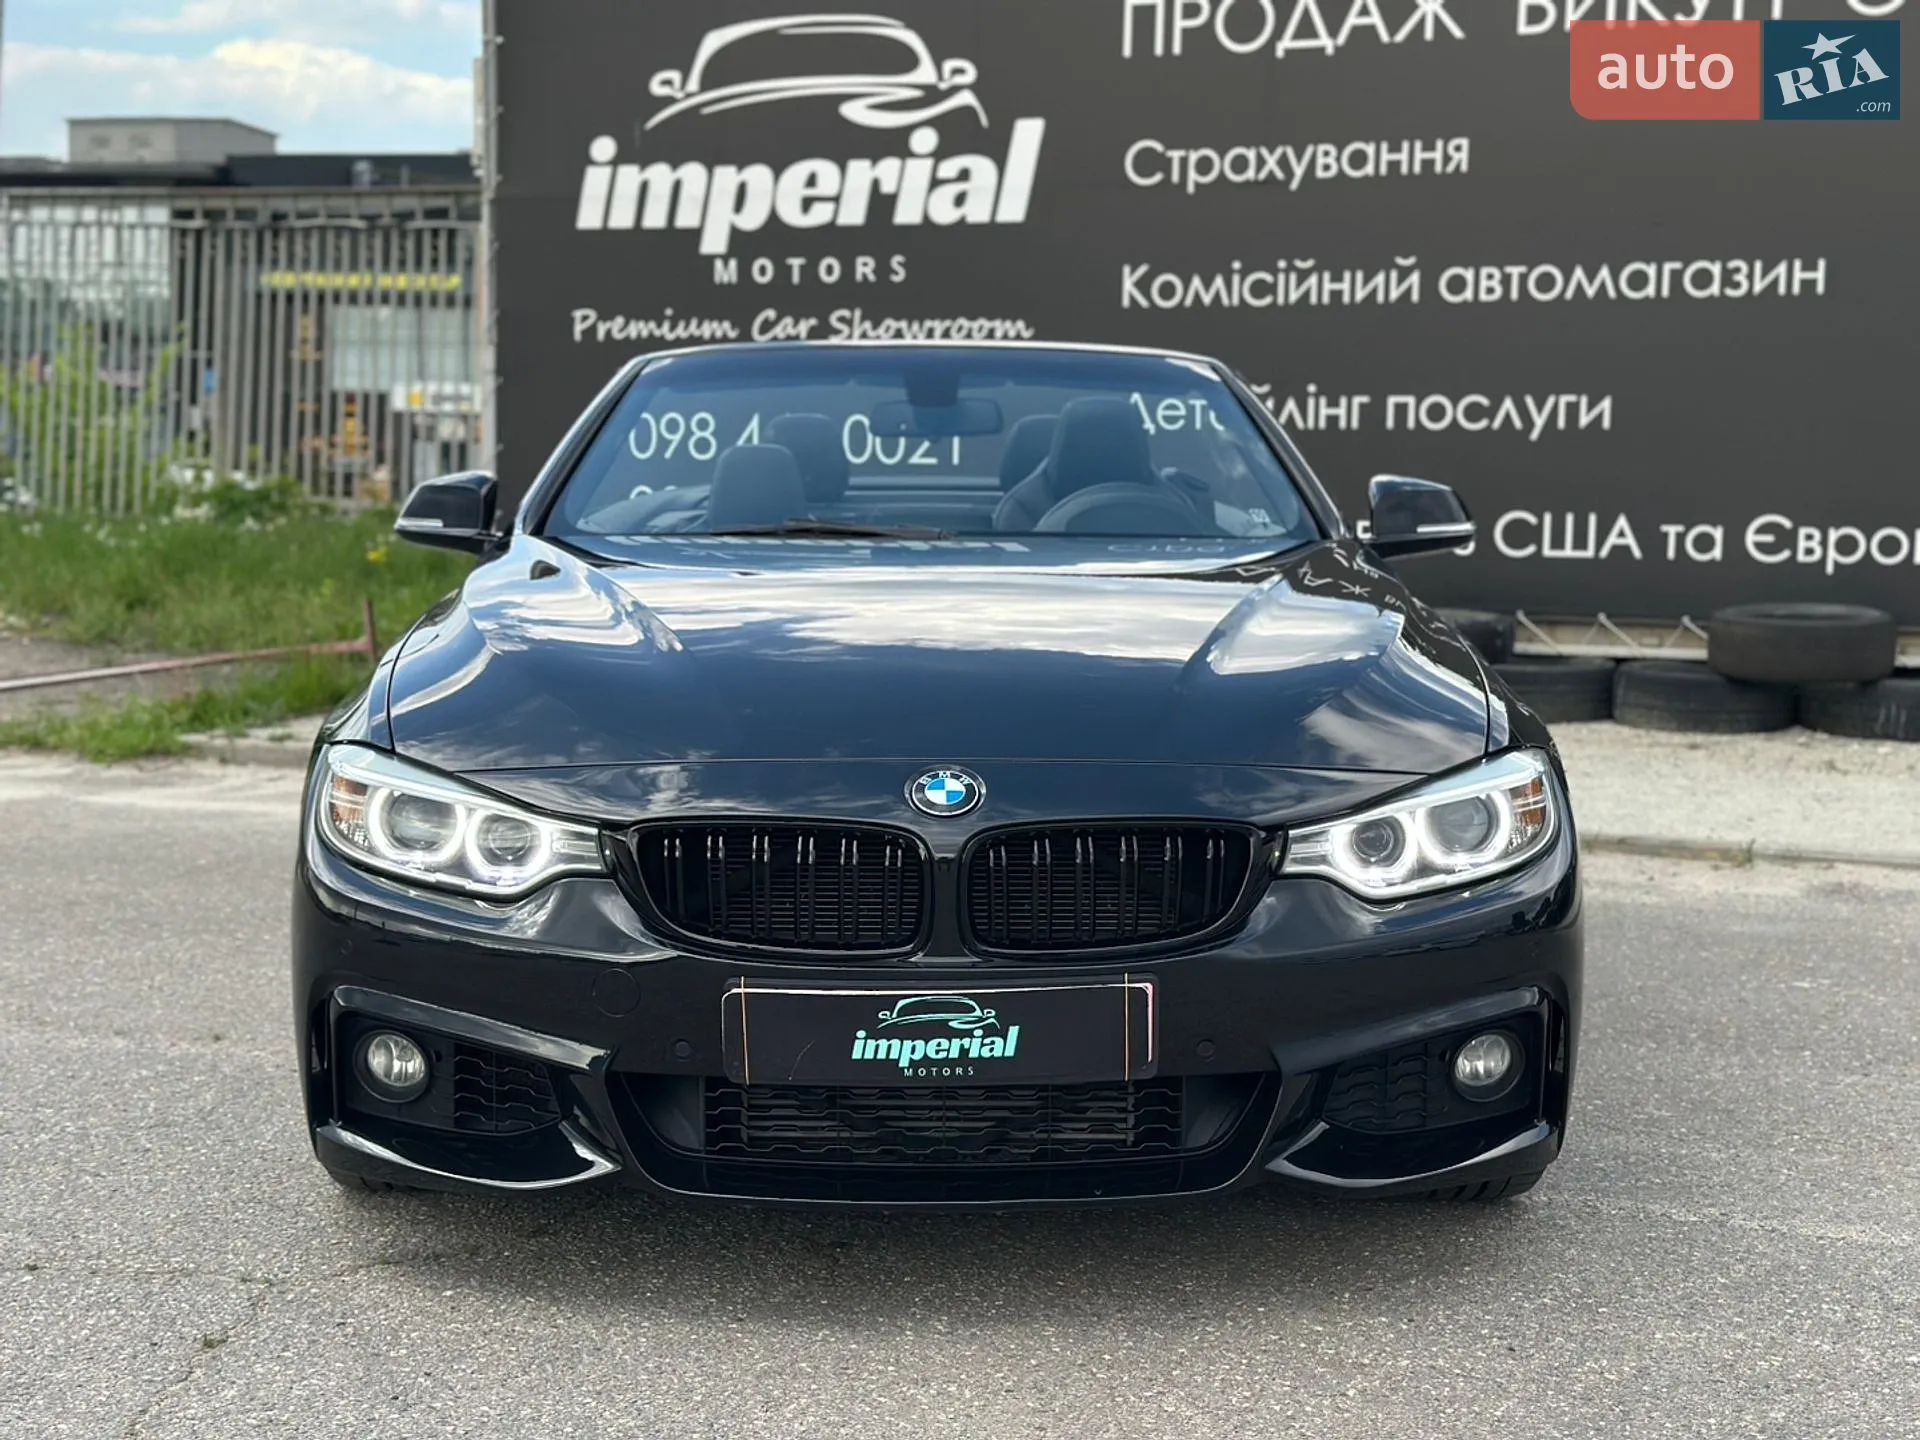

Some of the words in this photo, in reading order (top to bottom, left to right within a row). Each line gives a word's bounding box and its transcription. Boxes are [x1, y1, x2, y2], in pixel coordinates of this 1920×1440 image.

[1121, 0, 1466, 58] ПРОДАЖ
[576, 117, 1046, 255] imperial
[1124, 136, 1470, 194] Страхування
[713, 254, 907, 285] MOTORS
[1121, 255, 1421, 309] Комісійний
[1438, 257, 1827, 303] автомагазин
[571, 307, 738, 342] Premium
[751, 308, 819, 341] Car
[828, 307, 1035, 342] Showroom
[628, 412, 717, 460] 098
[1385, 393, 1613, 441] послуги
[1493, 509, 1643, 560] США
[1659, 523, 1724, 562] та
[1744, 513, 1920, 576] Євро
[851, 1025, 1020, 1068] imperial
[903, 1066, 974, 1077] MOTORS
